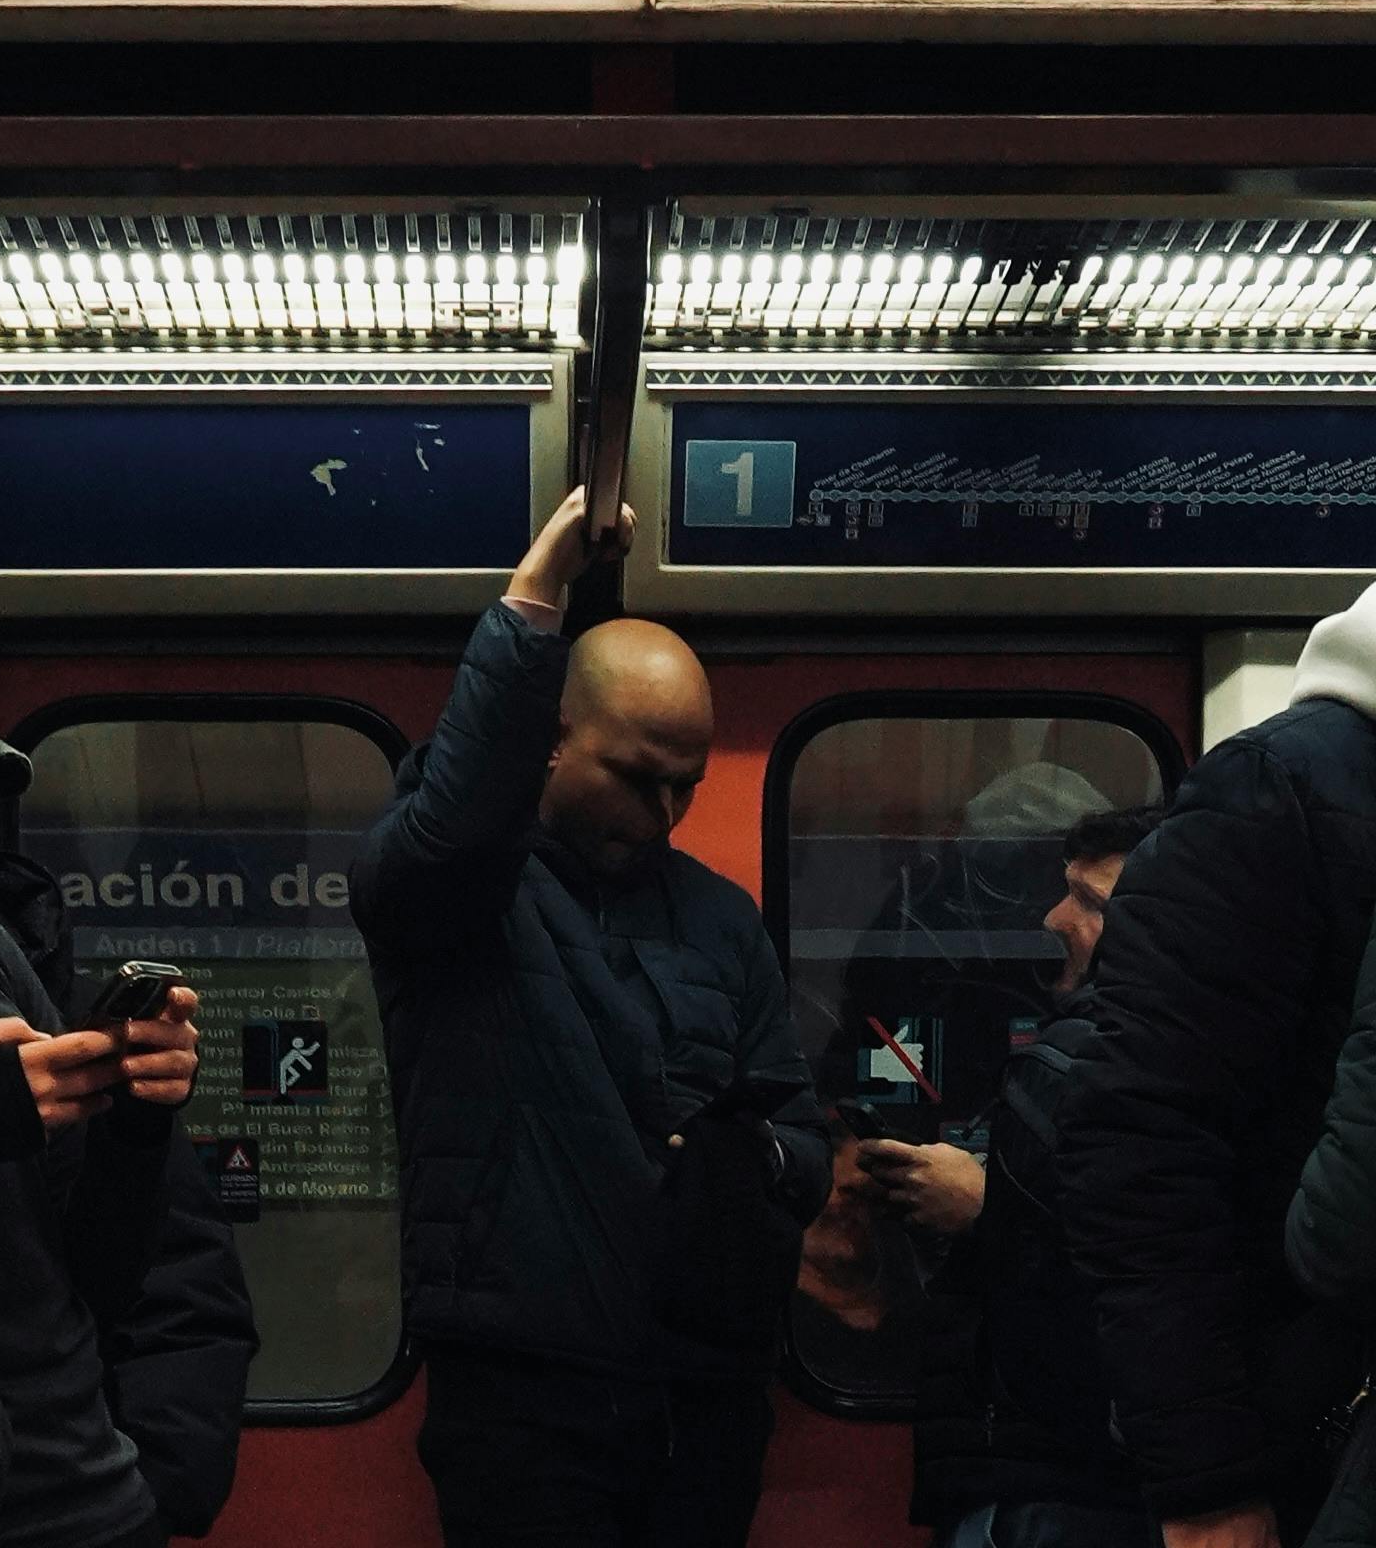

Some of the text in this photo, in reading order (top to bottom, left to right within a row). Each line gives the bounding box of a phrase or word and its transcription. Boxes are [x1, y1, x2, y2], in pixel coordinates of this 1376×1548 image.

[721, 452, 754, 516] 1
[60, 861, 244, 908] ación
[195, 986, 265, 1001] perador
[275, 1181, 297, 1196] de
[302, 1180, 369, 1200] Moyano
